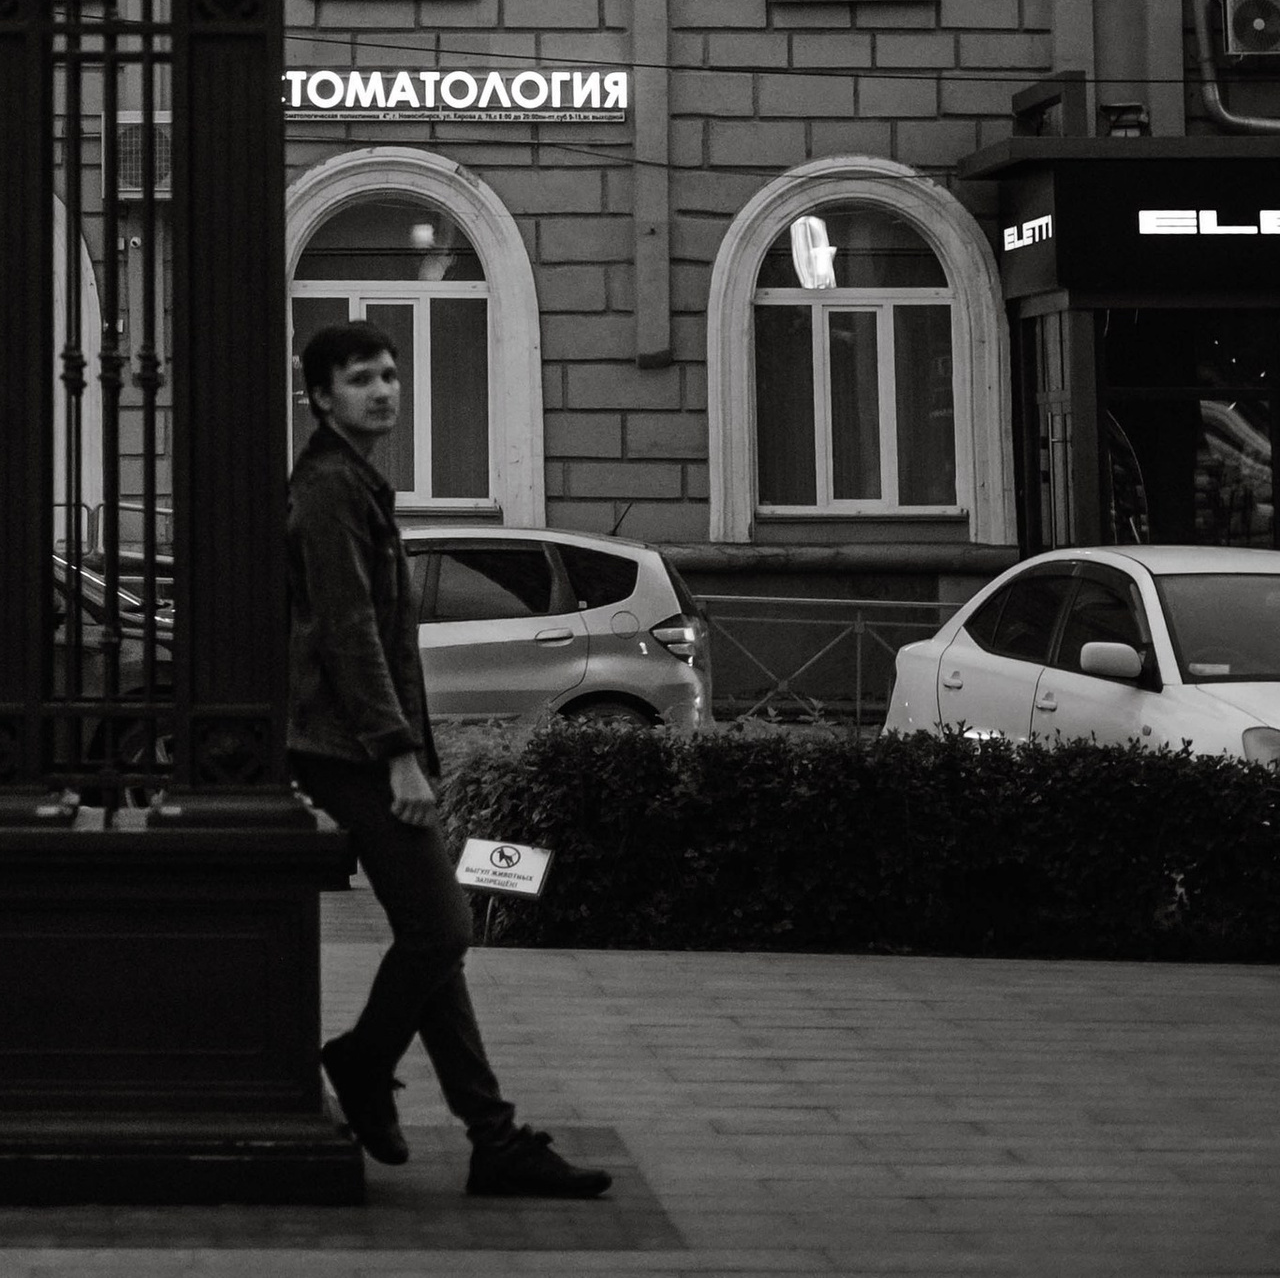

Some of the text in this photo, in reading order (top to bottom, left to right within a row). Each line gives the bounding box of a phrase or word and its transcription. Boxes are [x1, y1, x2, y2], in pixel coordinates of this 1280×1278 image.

[281, 70, 628, 109] ТОМАТОЛОГИЯ
[465, 866, 534, 881] ВЫГУЛ ЖИВОТНЫХ
